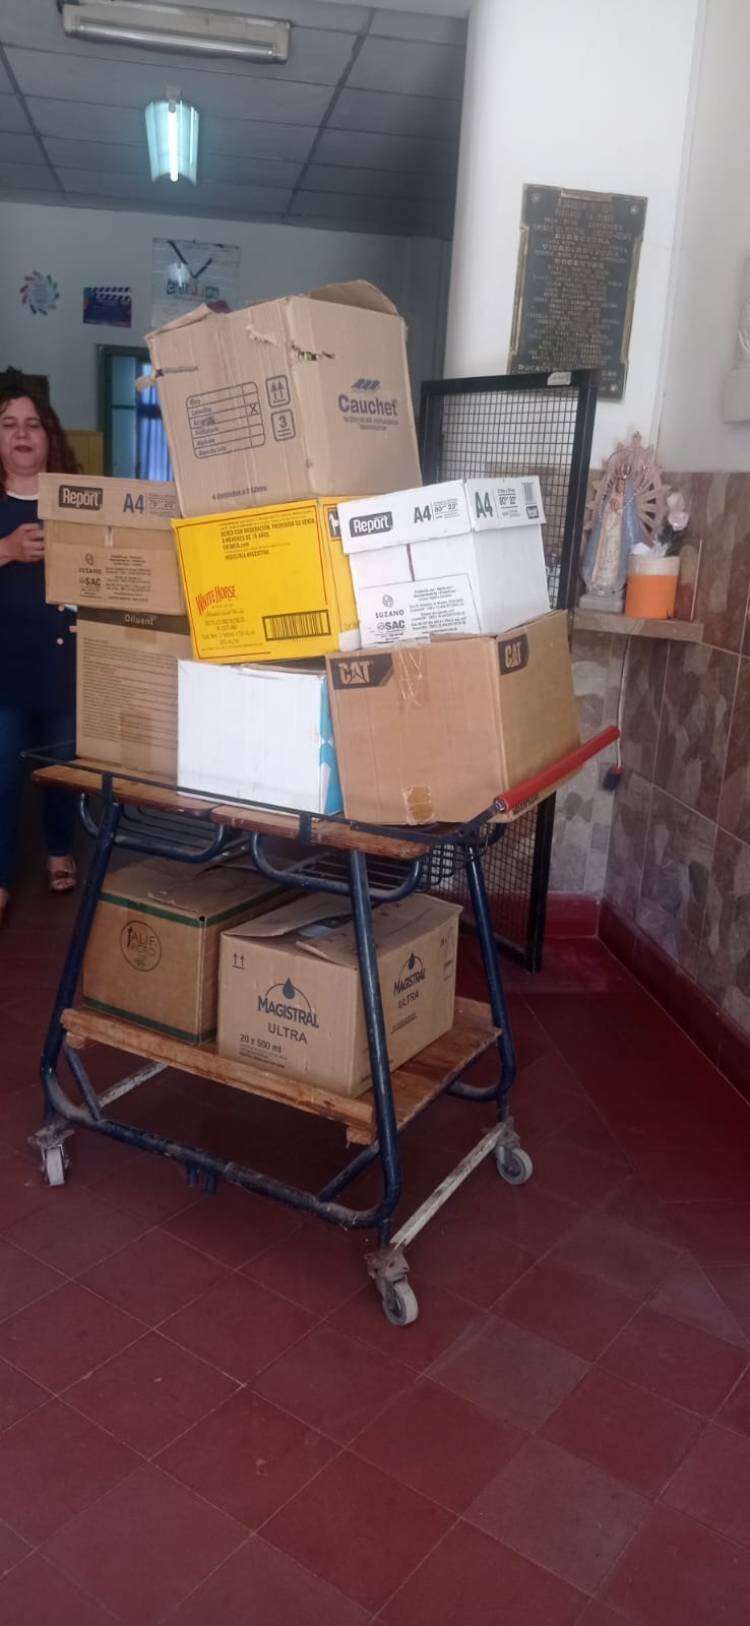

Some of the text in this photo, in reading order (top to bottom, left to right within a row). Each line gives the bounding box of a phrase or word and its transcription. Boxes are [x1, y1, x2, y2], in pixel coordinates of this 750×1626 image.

[338, 394, 398, 416] Cauchet
[279, 415, 288, 429] 3
[62, 487, 99, 508] Report
[122, 493, 145, 514] A4
[474, 492, 493, 519] A4
[352, 514, 390, 533] Report
[413, 505, 432, 524] A4
[375, 609, 405, 619] SUZANO
[385, 620, 405, 631] SAC
[504, 642, 521, 668] CAT
[338, 660, 370, 684] CAT
[393, 967, 426, 994] MAGISTRAL
[257, 995, 319, 1028] MAGISTRAL
[240, 1033, 250, 1041] 20
[256, 1038, 271, 1050] 500
[267, 1022, 307, 1044] ULTRA
